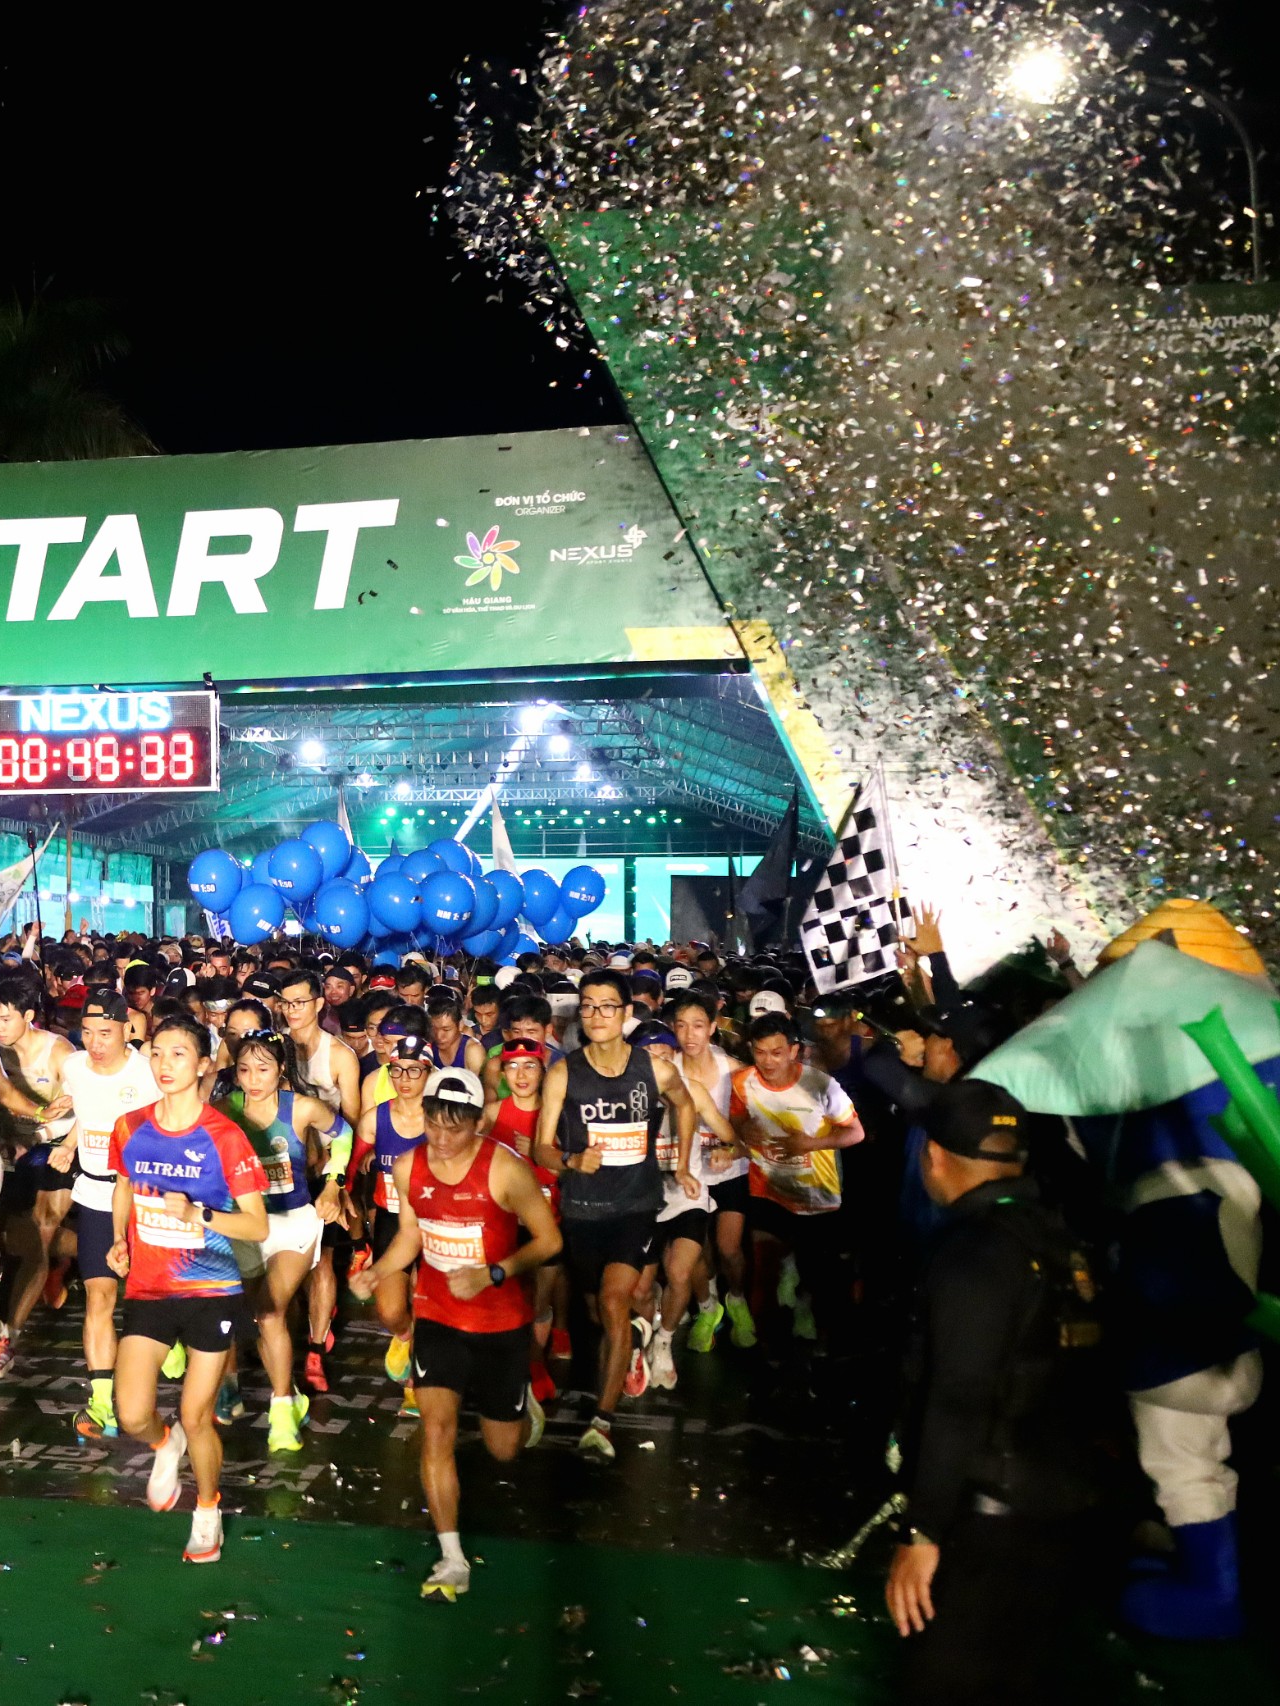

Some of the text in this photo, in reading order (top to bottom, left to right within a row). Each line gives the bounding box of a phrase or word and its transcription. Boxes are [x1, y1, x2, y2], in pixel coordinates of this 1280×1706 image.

[494, 496, 520, 507] ĐƠN
[522, 494, 535, 508] VỊ
[514, 504, 566, 516] ORGANIZER
[549, 543, 634, 566] NEXUS
[483, 595, 513, 605] GIANG
[19, 696, 172, 732] NEXUS
[135, 1160, 202, 1179] ULTRAIN
